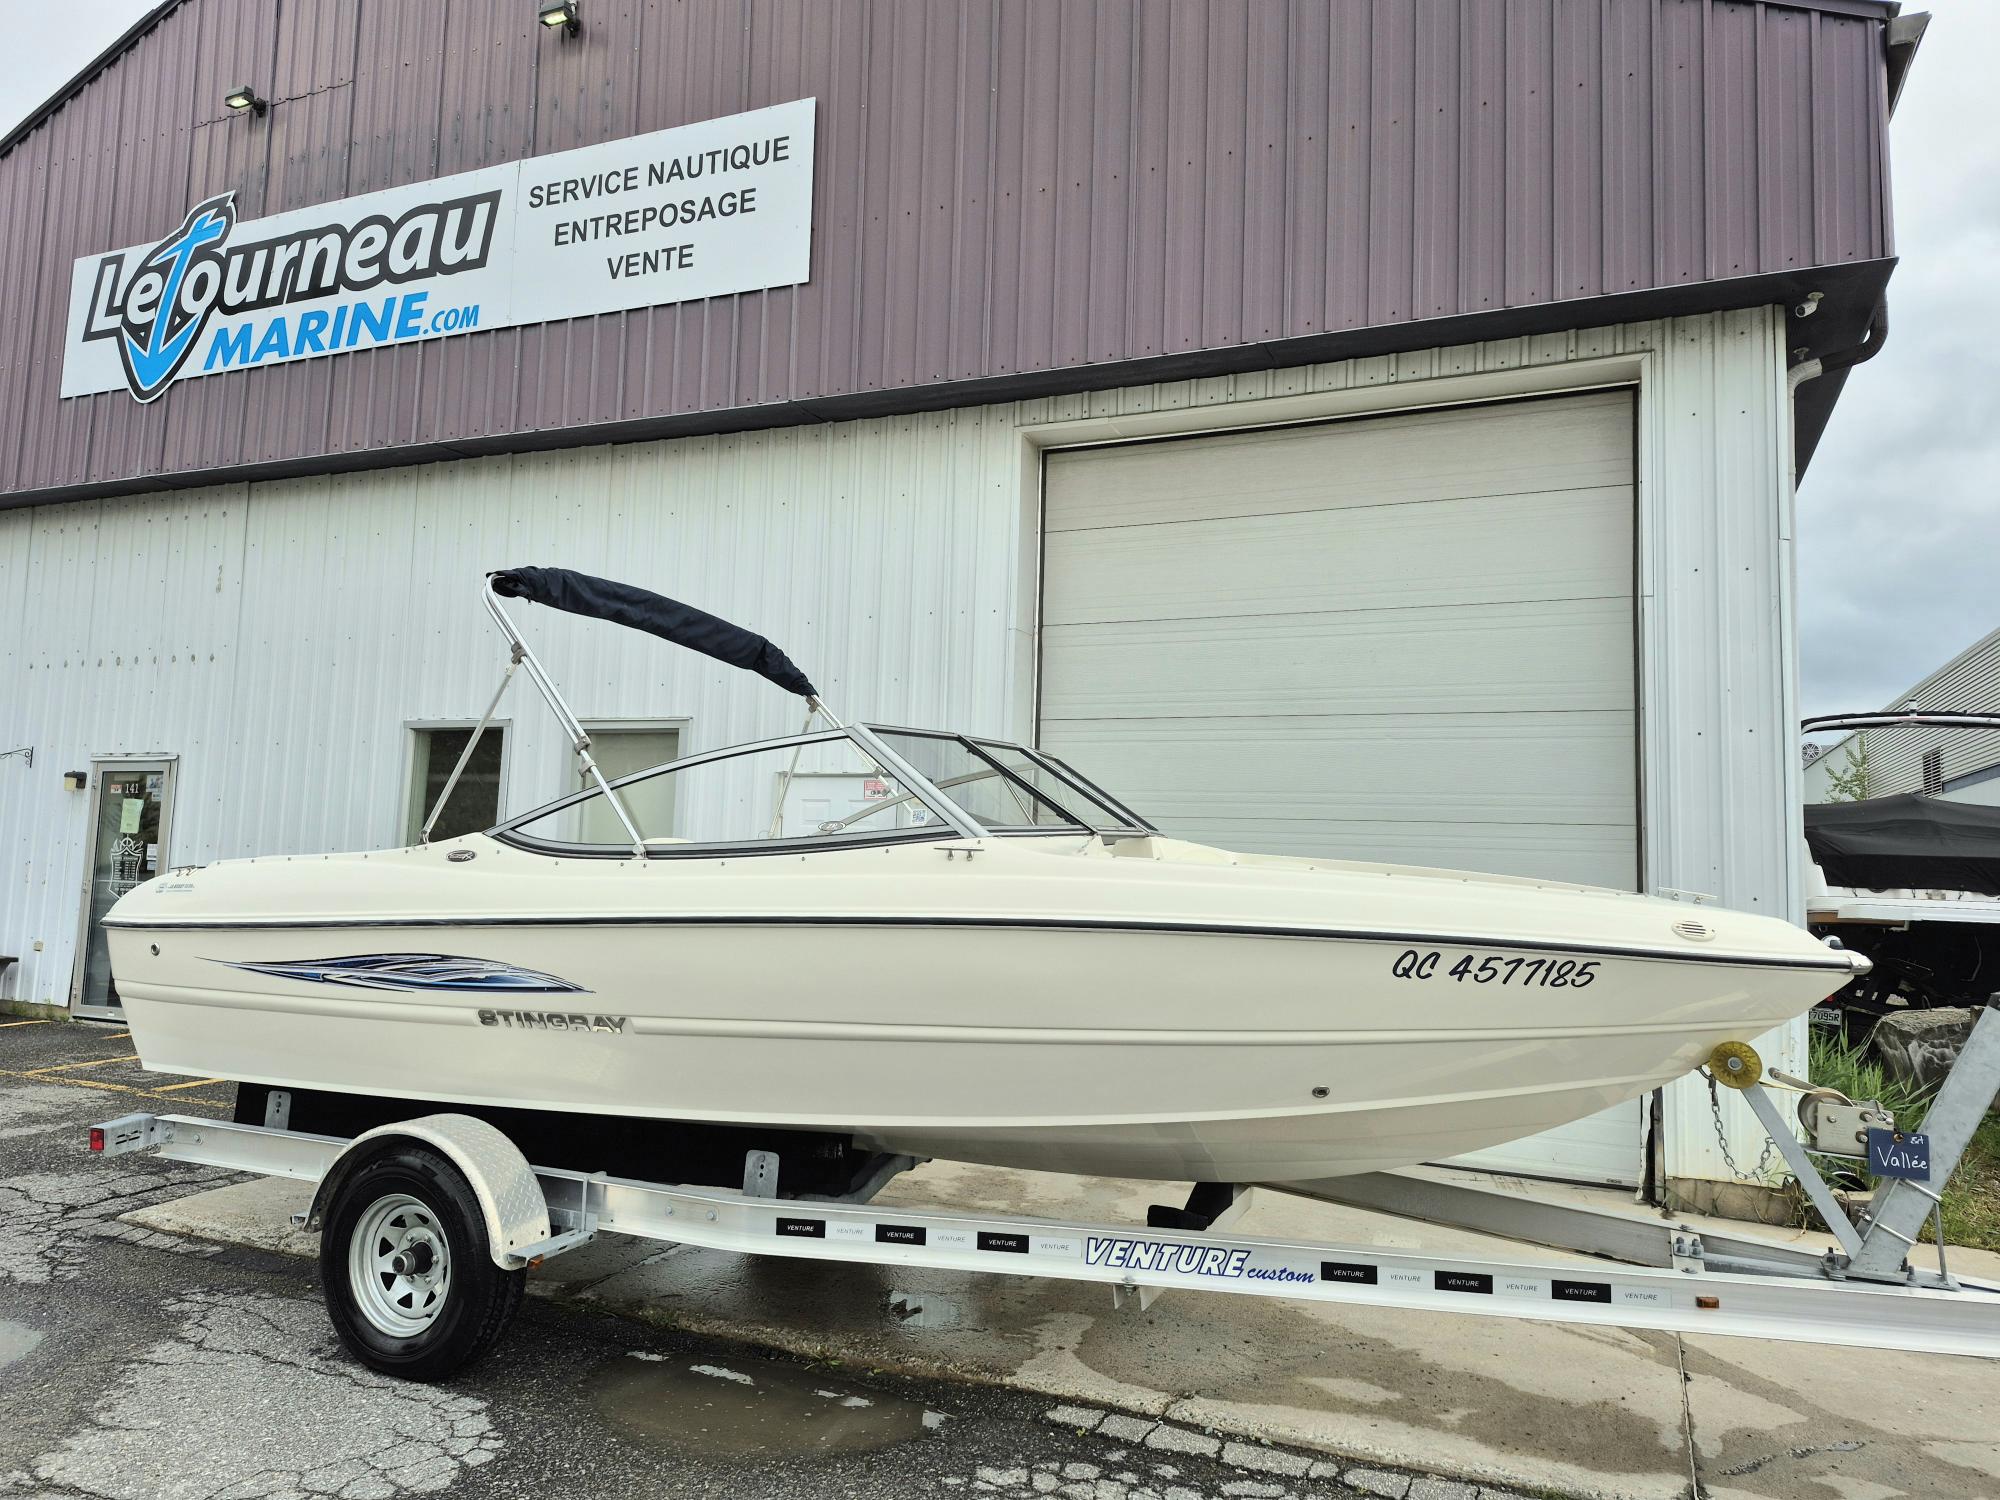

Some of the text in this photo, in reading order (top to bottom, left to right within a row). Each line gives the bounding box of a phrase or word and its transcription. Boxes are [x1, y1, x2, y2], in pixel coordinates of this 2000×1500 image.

[528, 135, 790, 209] SERVICE NAUTIQUE
[554, 188, 757, 246] ENTREPOSAGE
[607, 244, 694, 280] VENTE
[125, 783, 139, 794] 141
[1392, 949, 1601, 988] QC 4577185
[1808, 1010, 1840, 1022] 7095R
[477, 1009, 626, 1034] STINGRAY
[1877, 1144, 1928, 1169] Vallée
[786, 1224, 815, 1232] VENTURE
[886, 1231, 915, 1239] VENTURE
[988, 1239, 1017, 1247] VENTURE
[1040, 1243, 1070, 1251] VENTURE
[1086, 1237, 1316, 1284] VENTURE custom
[1333, 1269, 1365, 1278] VENTURE
[1390, 1274, 1421, 1282] VENTURE
[1447, 1278, 1479, 1287] VENTURE
[1506, 1283, 1538, 1292] VENTURE
[1564, 1288, 1598, 1296] VENTURE
[1624, 1292, 1658, 1301] VENTURE
